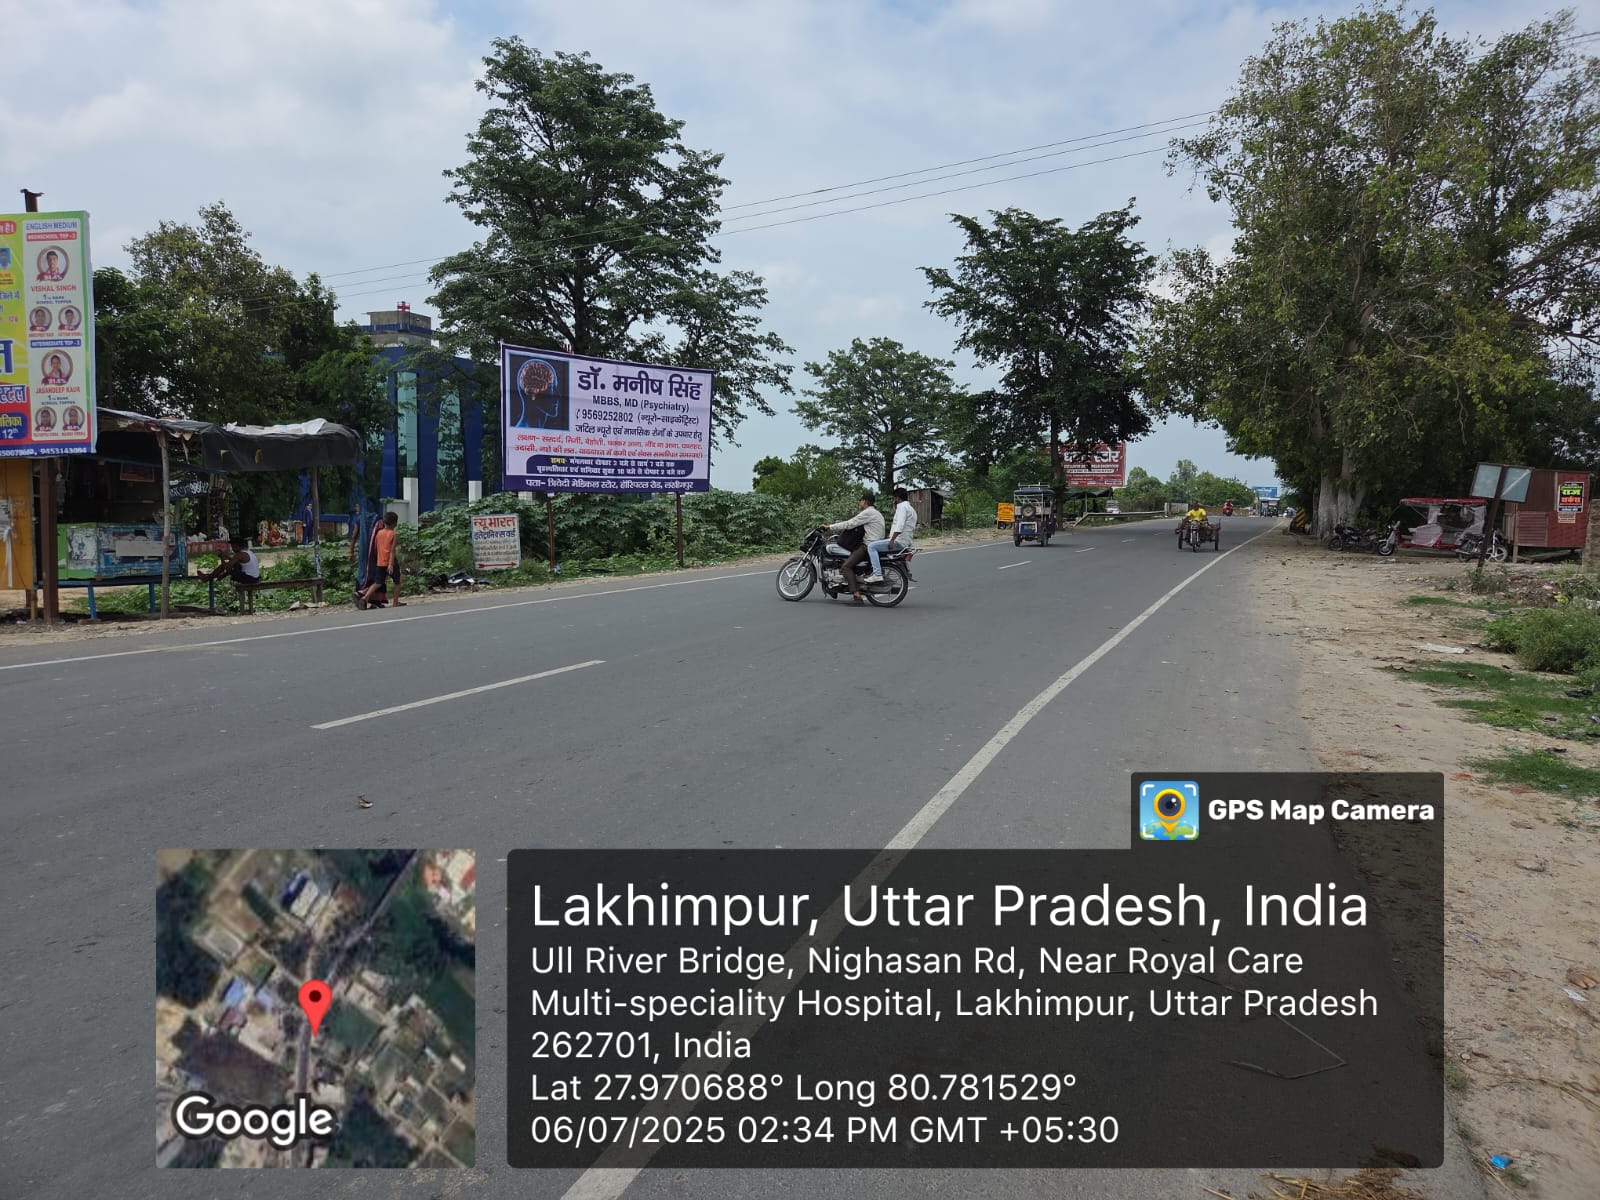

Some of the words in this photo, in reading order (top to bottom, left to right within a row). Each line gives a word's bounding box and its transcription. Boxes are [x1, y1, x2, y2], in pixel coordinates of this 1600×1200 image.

[577, 366, 606, 390] डॉ.
[612, 370, 664, 396] मनीष
[668, 374, 703, 400] सिंह
[592, 395, 622, 408] MBBS,
[624, 398, 638, 408] MD
[640, 400, 690, 413] (Psychiatry)
[582, 409, 634, 422] 9569252802
[575, 423, 595, 434] जटिल
[597, 424, 611, 438] न्यूरो
[613, 426, 624, 435] एवं
[624, 426, 650, 436] मानसिक
[667, 428, 673, 438] के
[674, 430, 693, 438] उपचार
[694, 430, 703, 442] हेतु
[526, 479, 546, 488] पता-
[572, 479, 600, 489] मेडिकल
[600, 480, 618, 490] स्टोर,
[650, 481, 663, 490] रोड,
[474, 518, 489, 531] न्यू
[489, 516, 516, 528] भारत
